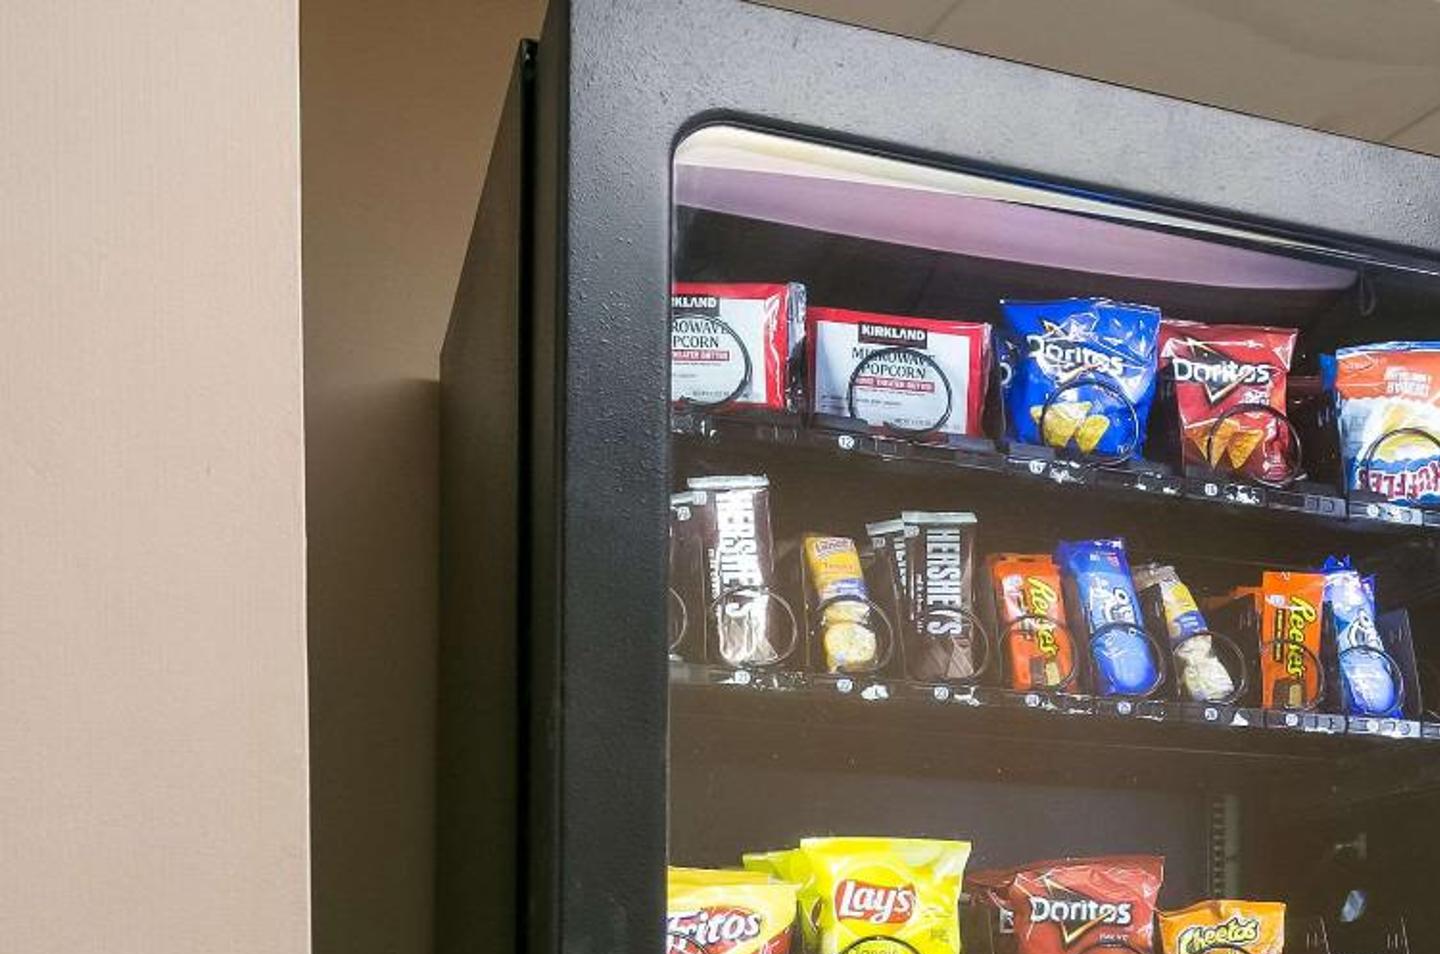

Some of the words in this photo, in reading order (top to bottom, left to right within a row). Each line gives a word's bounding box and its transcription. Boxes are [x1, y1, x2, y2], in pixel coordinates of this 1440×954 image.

[673, 335, 719, 348] PCORN
[861, 323, 926, 341] KIRKLAND
[1026, 334, 1124, 375] Doritos
[860, 362, 926, 379] POPCORN
[1172, 358, 1270, 383] Doritos
[1286, 596, 1317, 679] Reese's
[838, 879, 913, 924] Lay's
[1030, 897, 1132, 925] Doritos
